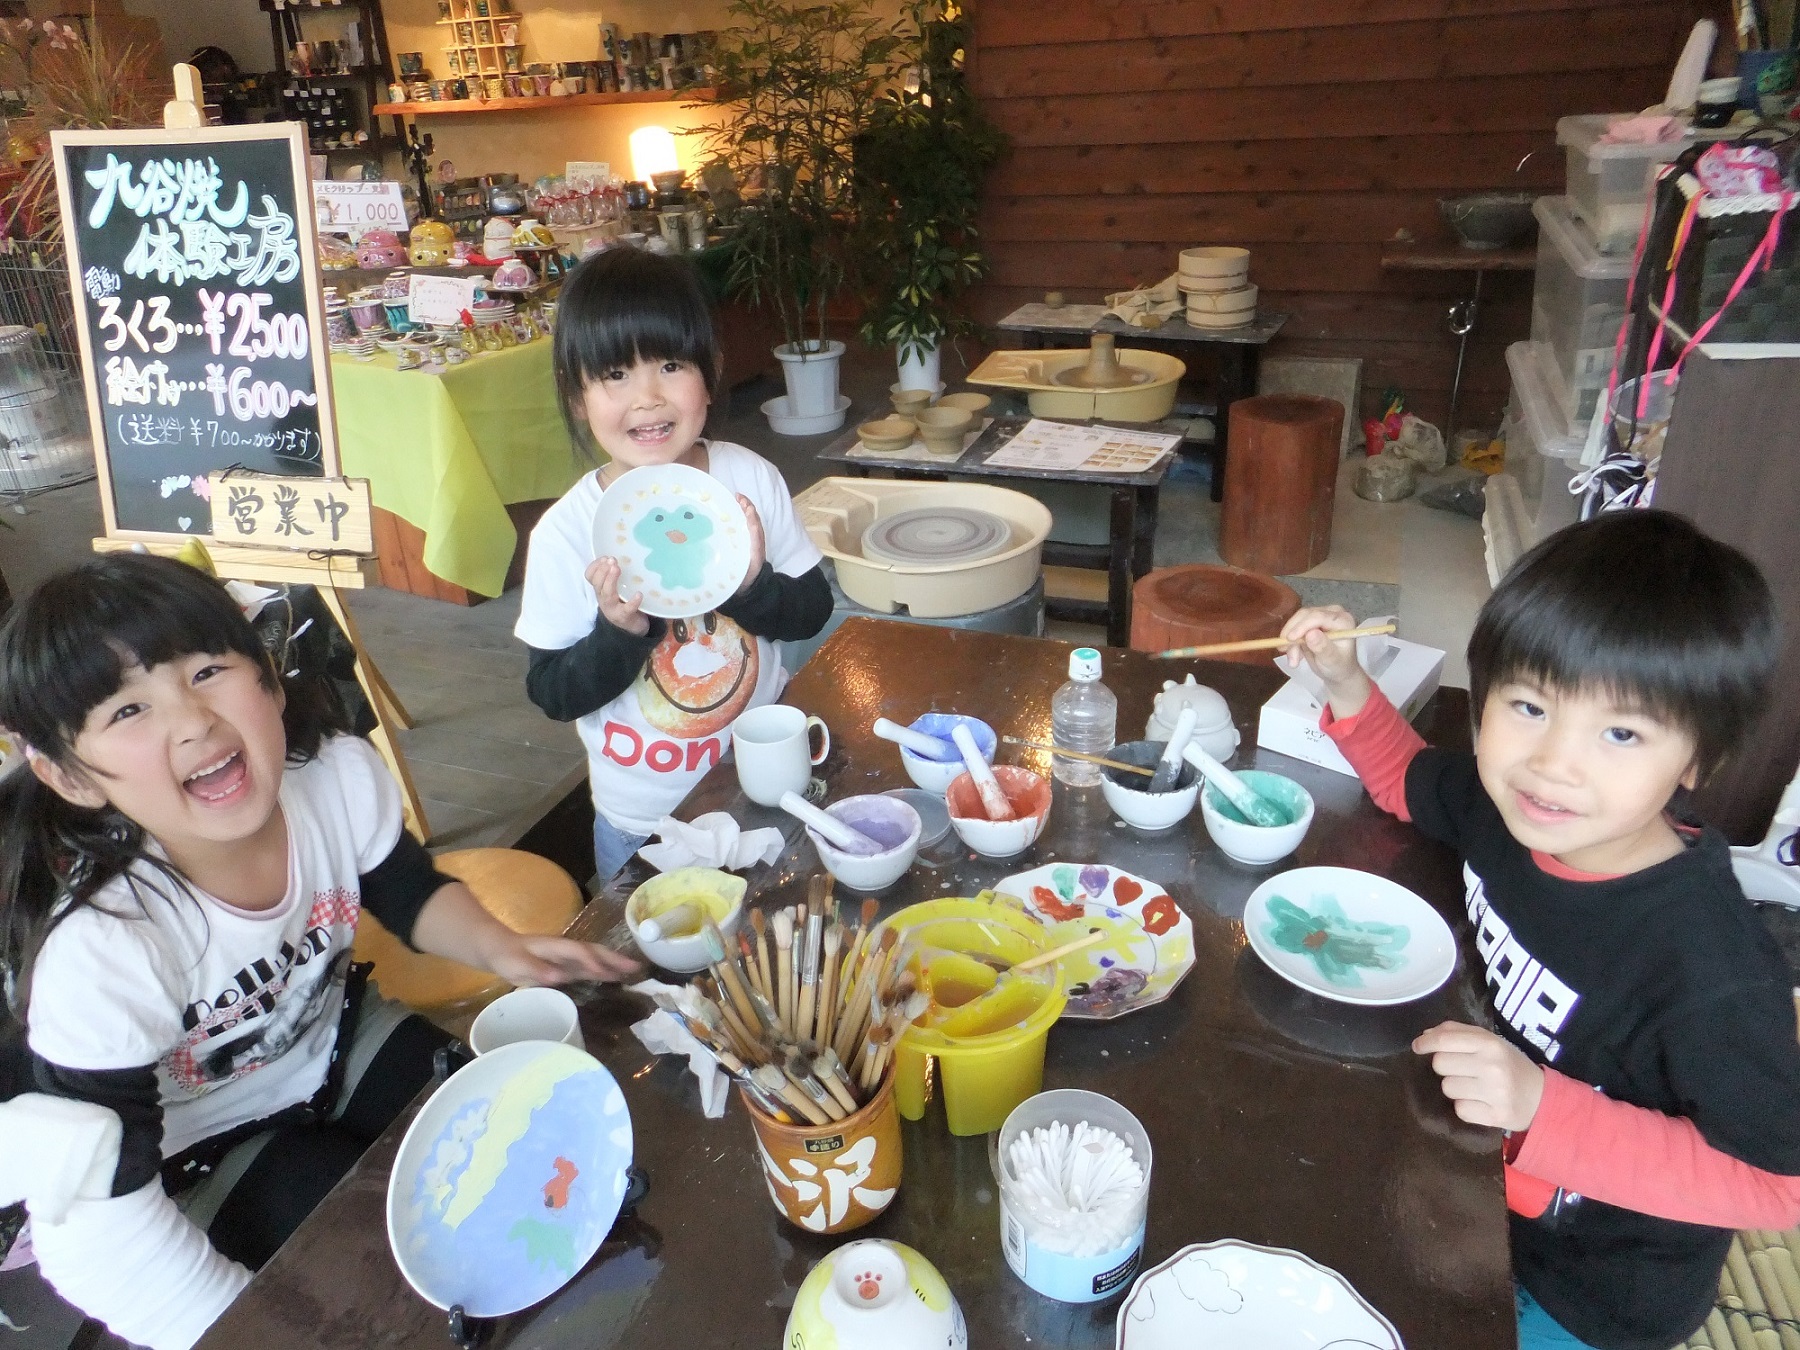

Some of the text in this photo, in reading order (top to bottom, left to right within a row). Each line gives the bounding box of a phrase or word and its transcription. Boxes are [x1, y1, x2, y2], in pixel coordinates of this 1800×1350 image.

[85, 153, 249, 228] 九谷焼
[124, 194, 300, 287] 体験工房
[228, 484, 350, 542] 営業中
[602, 721, 734, 773] Don
